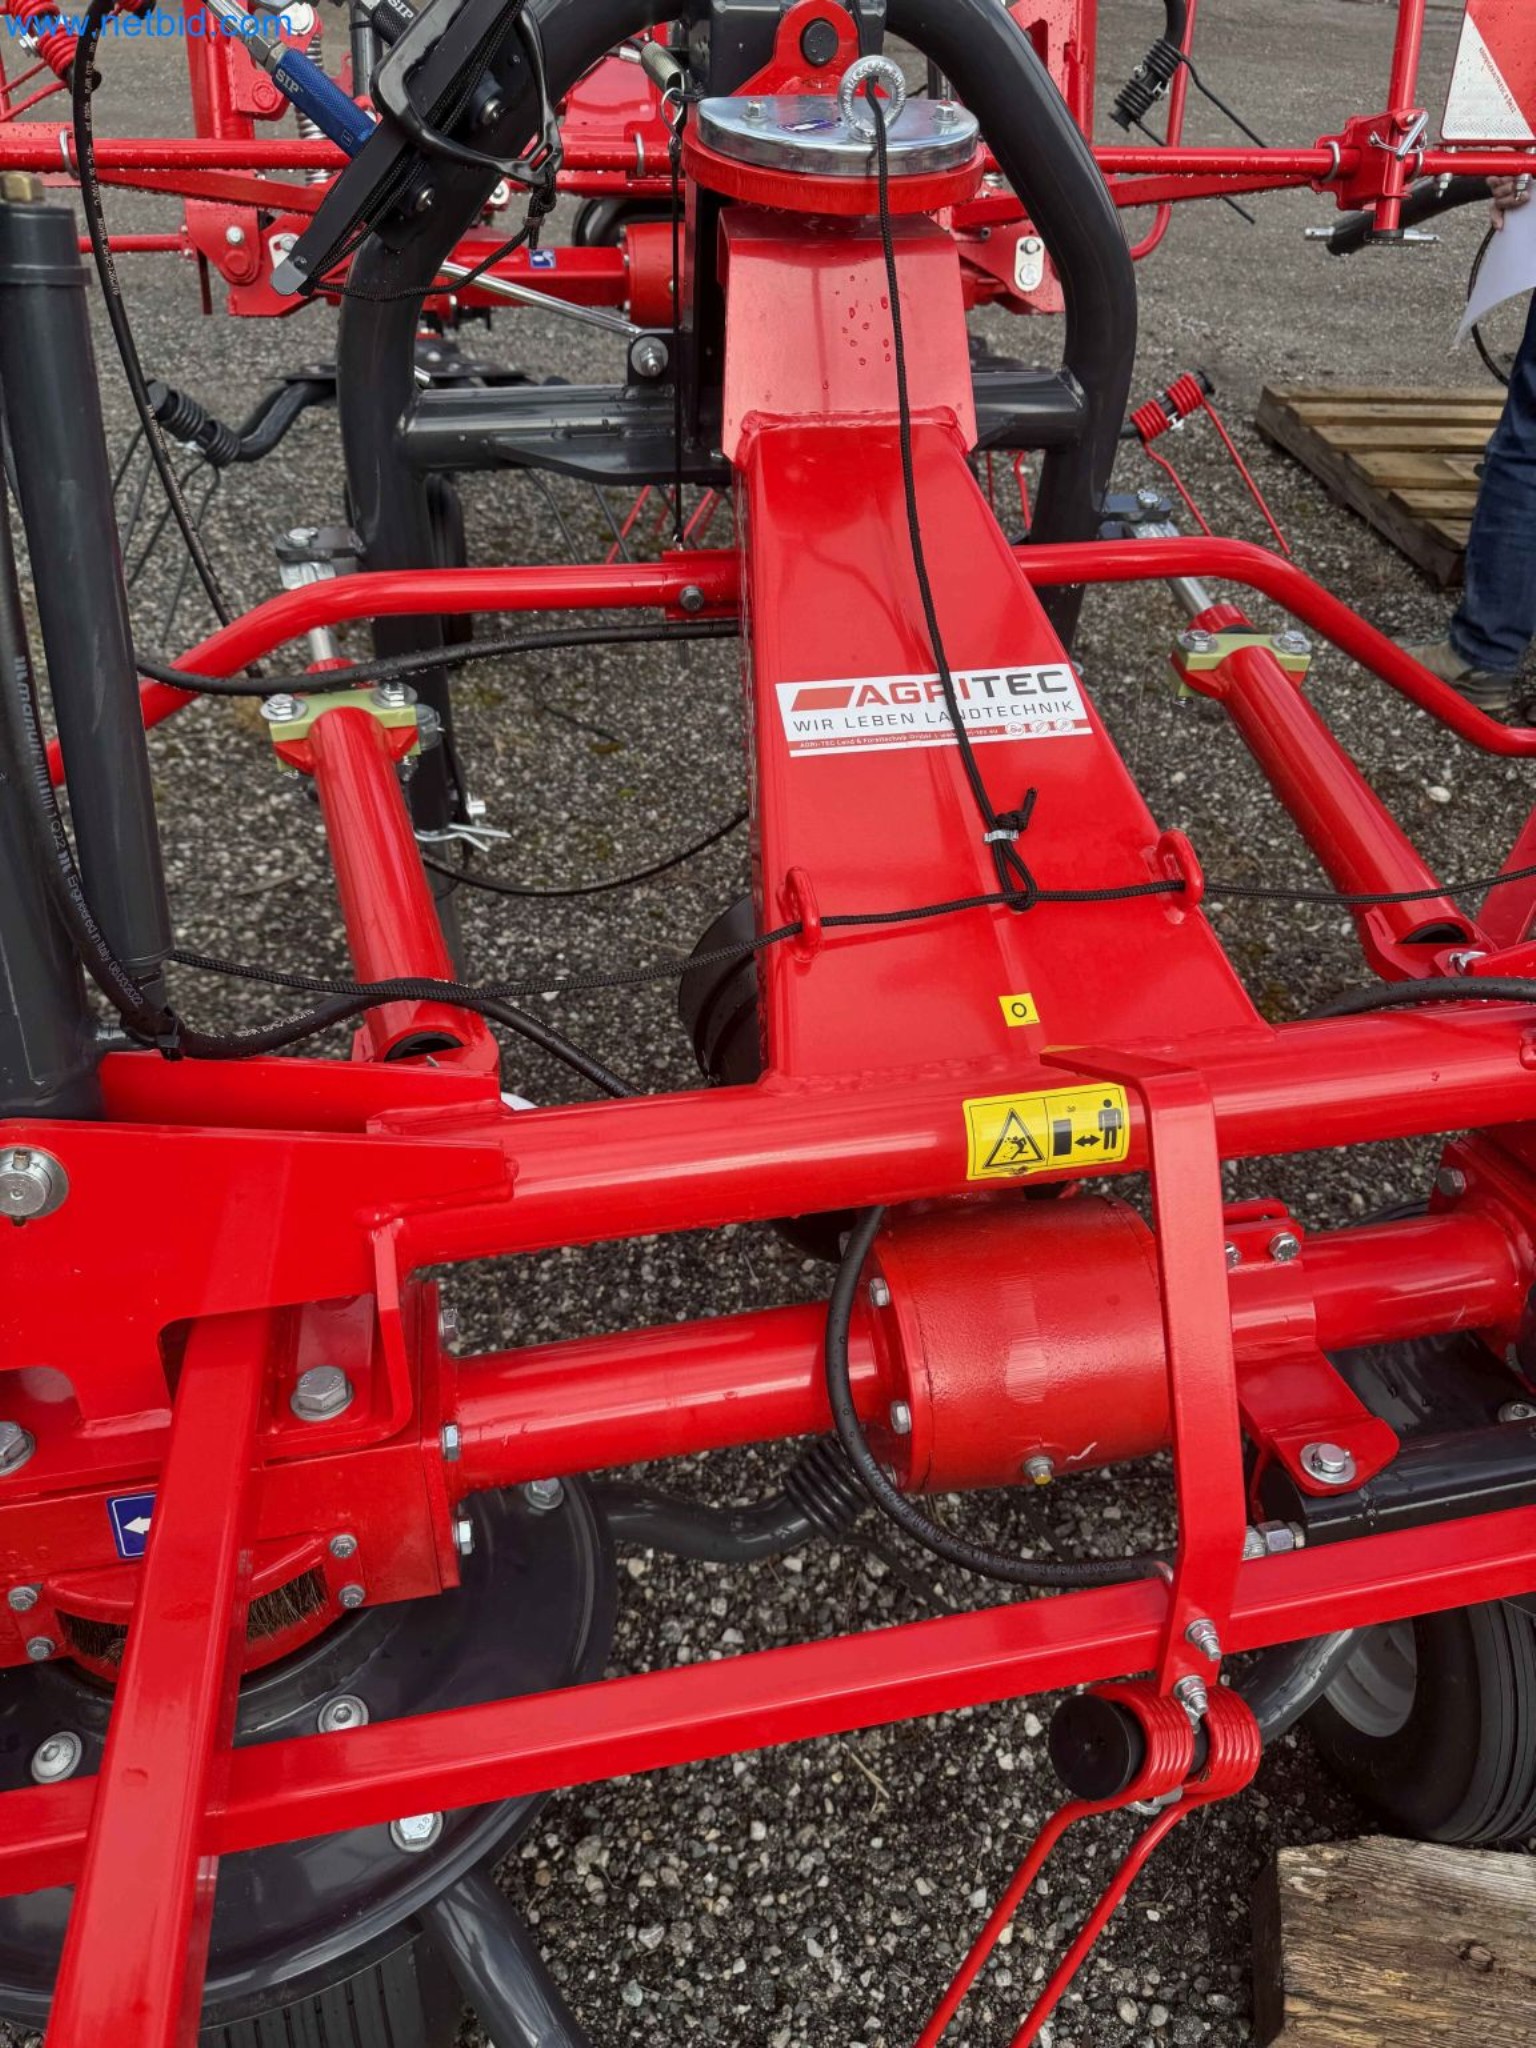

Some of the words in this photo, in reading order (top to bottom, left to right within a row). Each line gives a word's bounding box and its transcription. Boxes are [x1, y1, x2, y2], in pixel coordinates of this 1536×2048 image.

[387, 0, 415, 19] SIP
[275, 68, 301, 94] SIP
[793, 719, 835, 733] WIR
[844, 712, 915, 728] LEBEN
